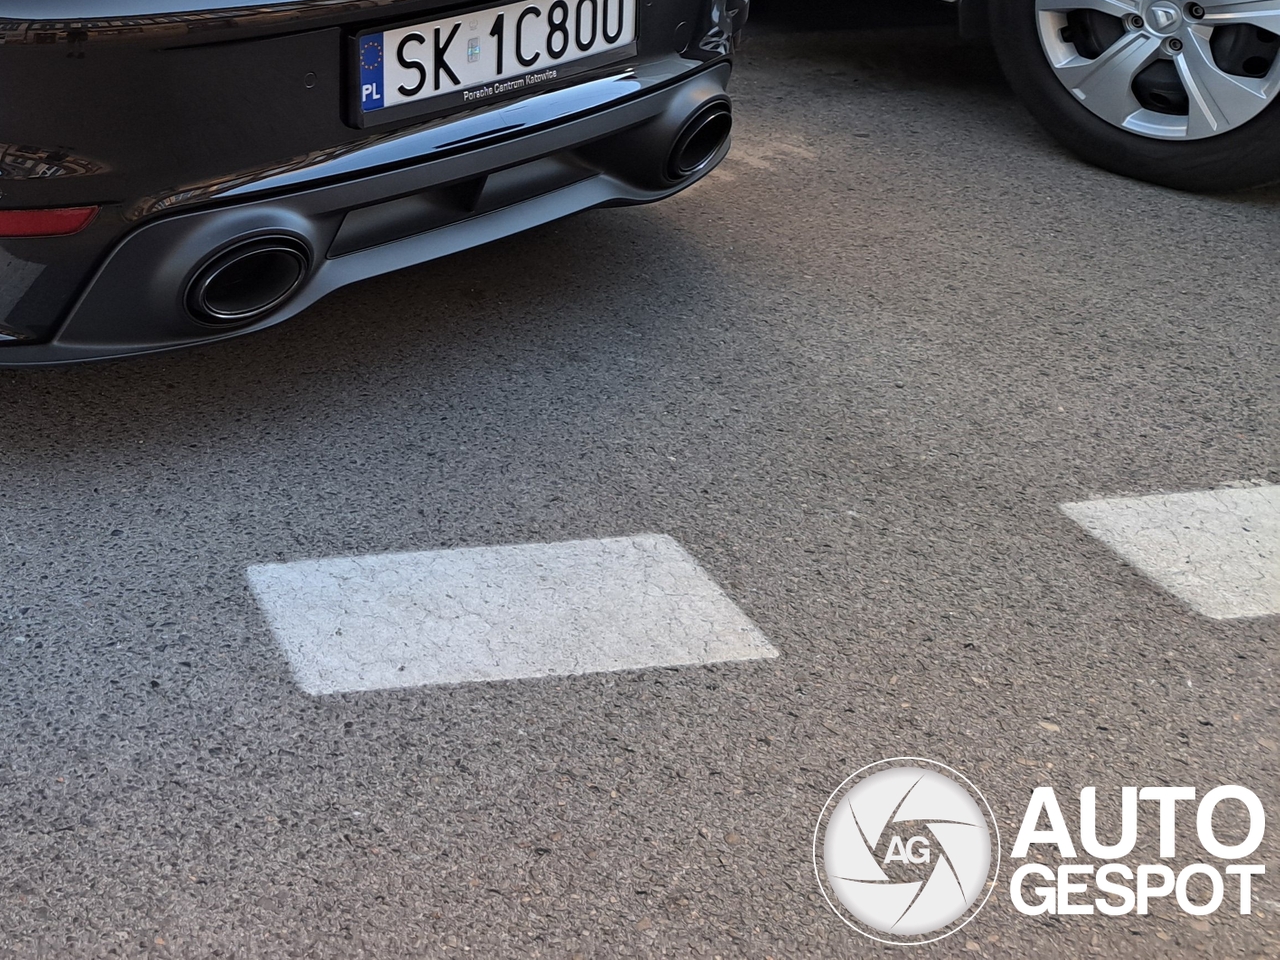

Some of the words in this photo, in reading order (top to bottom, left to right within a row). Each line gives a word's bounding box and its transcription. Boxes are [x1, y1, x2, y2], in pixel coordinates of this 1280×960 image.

[396, 20, 462, 98] SK
[361, 83, 381, 103] PL
[462, 85, 494, 102] Porsche
[493, 78, 526, 95] Centrum
[525, 69, 558, 87] Katowice
